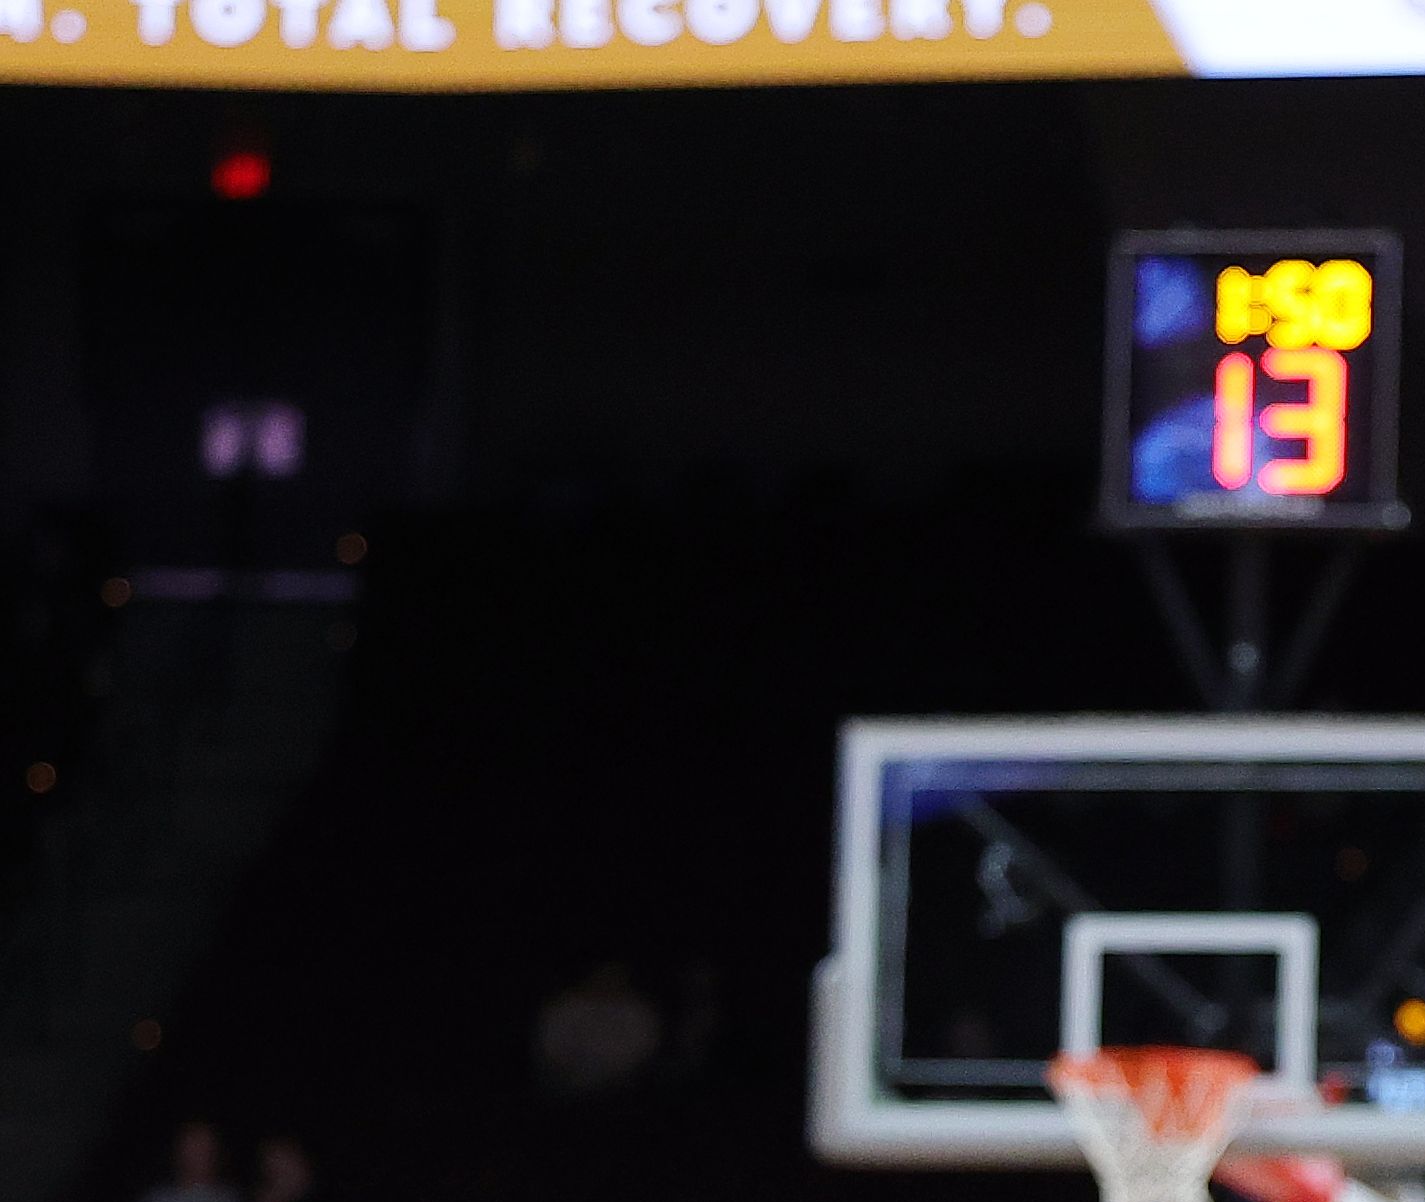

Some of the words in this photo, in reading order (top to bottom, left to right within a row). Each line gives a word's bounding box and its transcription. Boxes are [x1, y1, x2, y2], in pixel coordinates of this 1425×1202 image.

[128, 0, 456, 51] TOTAL
[1216, 259, 1372, 350] 1:50
[1212, 346, 1347, 495] 13
